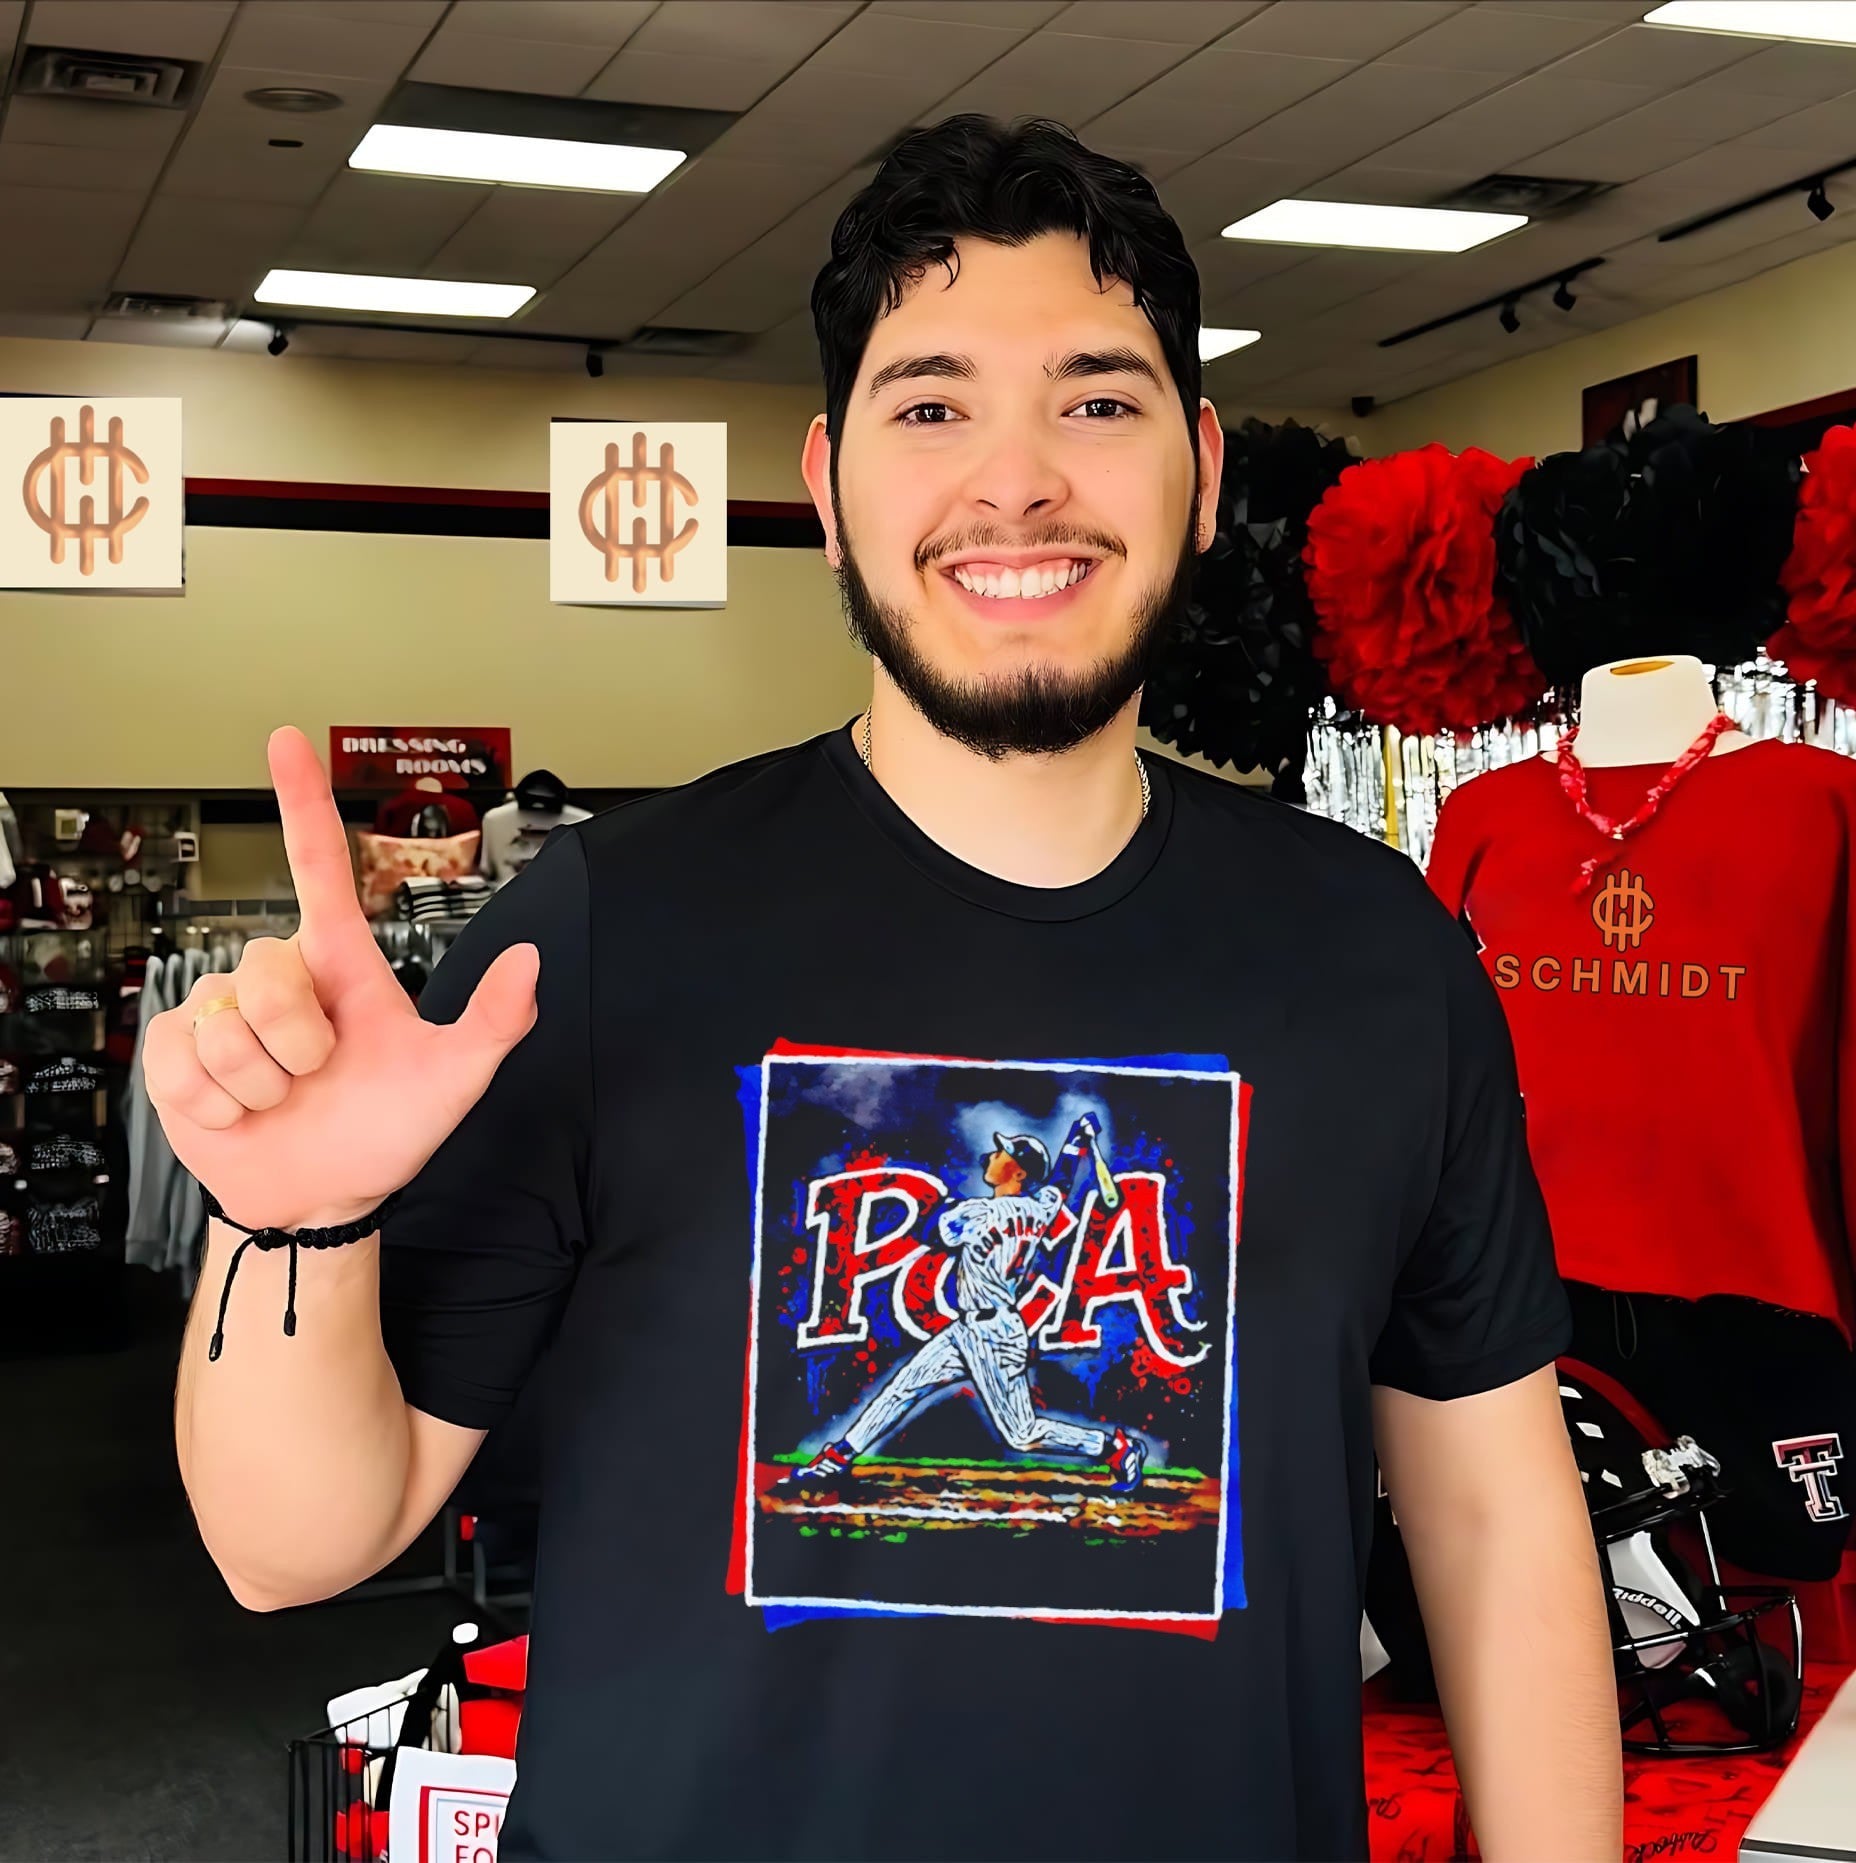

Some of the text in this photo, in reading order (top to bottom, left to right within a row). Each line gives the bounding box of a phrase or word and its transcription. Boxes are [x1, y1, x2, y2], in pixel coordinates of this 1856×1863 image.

[342, 737, 467, 754] DRESSING
[396, 758, 487, 775] ROOMS
[1494, 953, 1747, 1001] SCHMIDT
